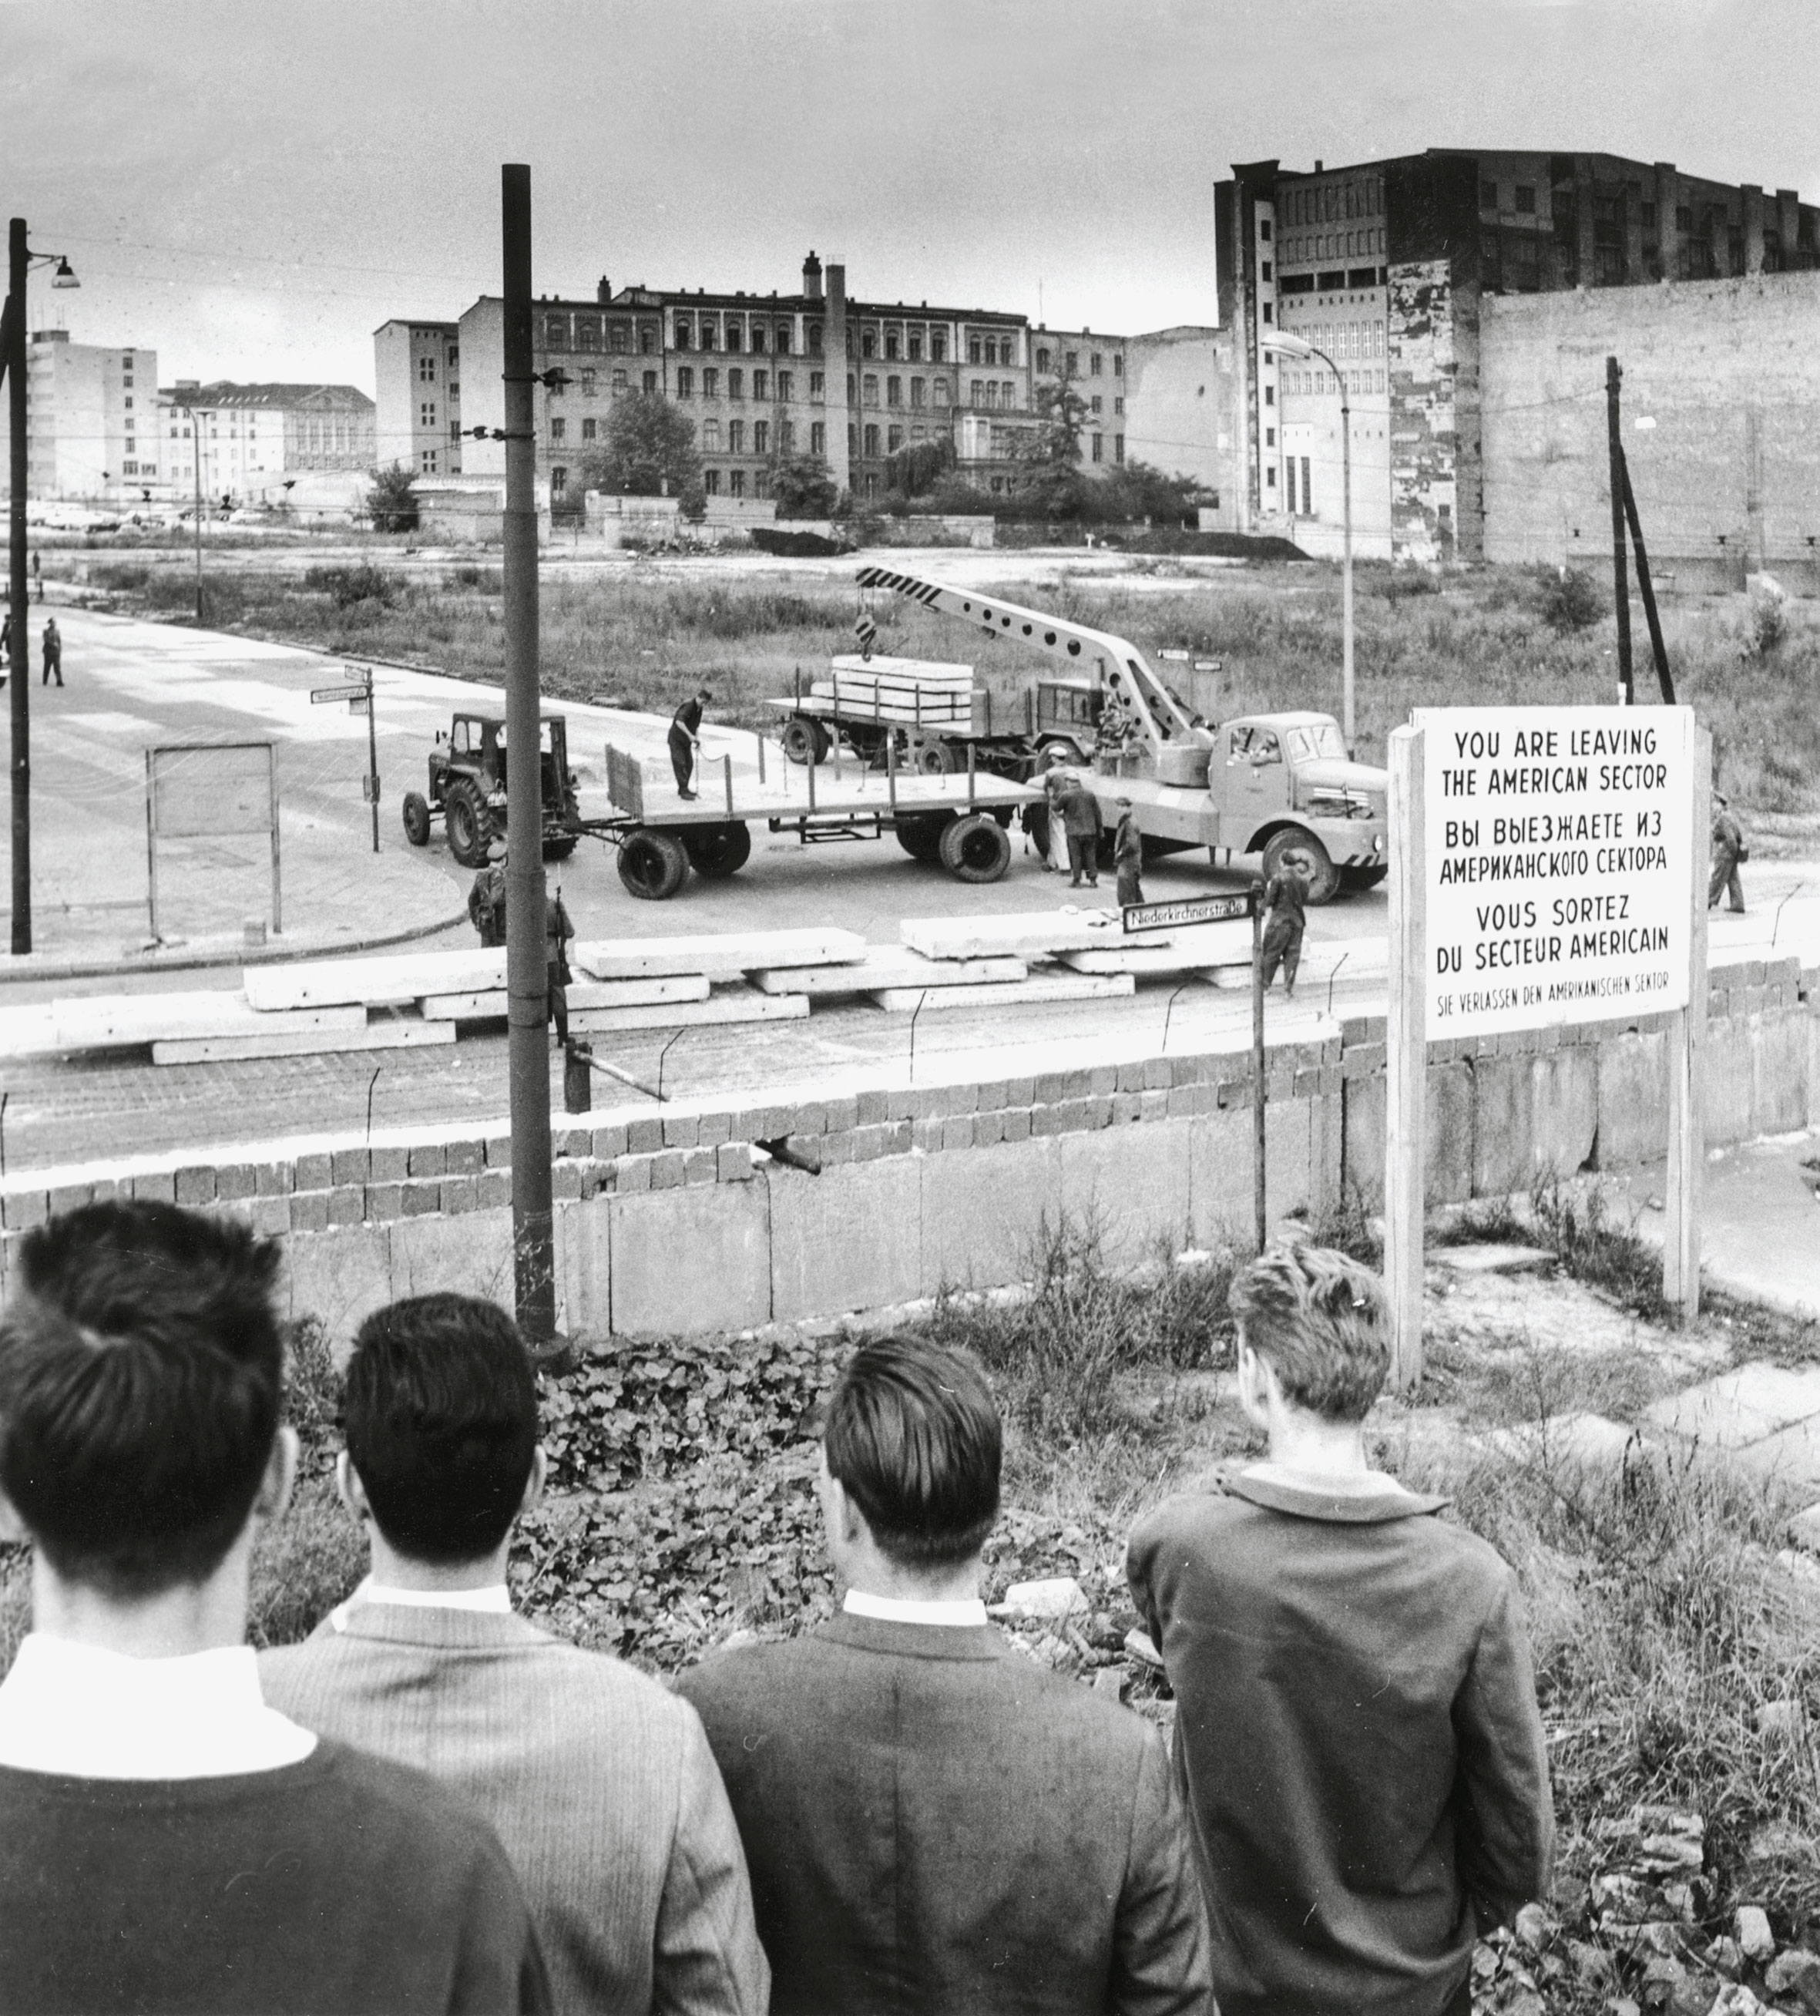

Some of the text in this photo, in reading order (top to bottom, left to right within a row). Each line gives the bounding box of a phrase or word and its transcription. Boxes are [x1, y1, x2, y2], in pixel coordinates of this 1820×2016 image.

[1455, 728, 1656, 758] YOU ARE LEAVING
[1442, 764, 1667, 796] THE AMERICAN SECTOR
[1446, 811, 1661, 848] ВЫ ВЫЕЗЖАЕТЕ ИЗ
[1440, 846, 1667, 885] АМЕРИКАНСКОГО СЕКТОРА
[1132, 900, 1242, 926] Niederkirchnerstraße
[1476, 895, 1629, 931] VOUS SORTEZ
[1437, 926, 1667, 974] DU SECTEUR AMERICAIN
[1438, 971, 1668, 1016] SIE VERLASSEN DEN AMERIKANISCHEN SEKTOR
